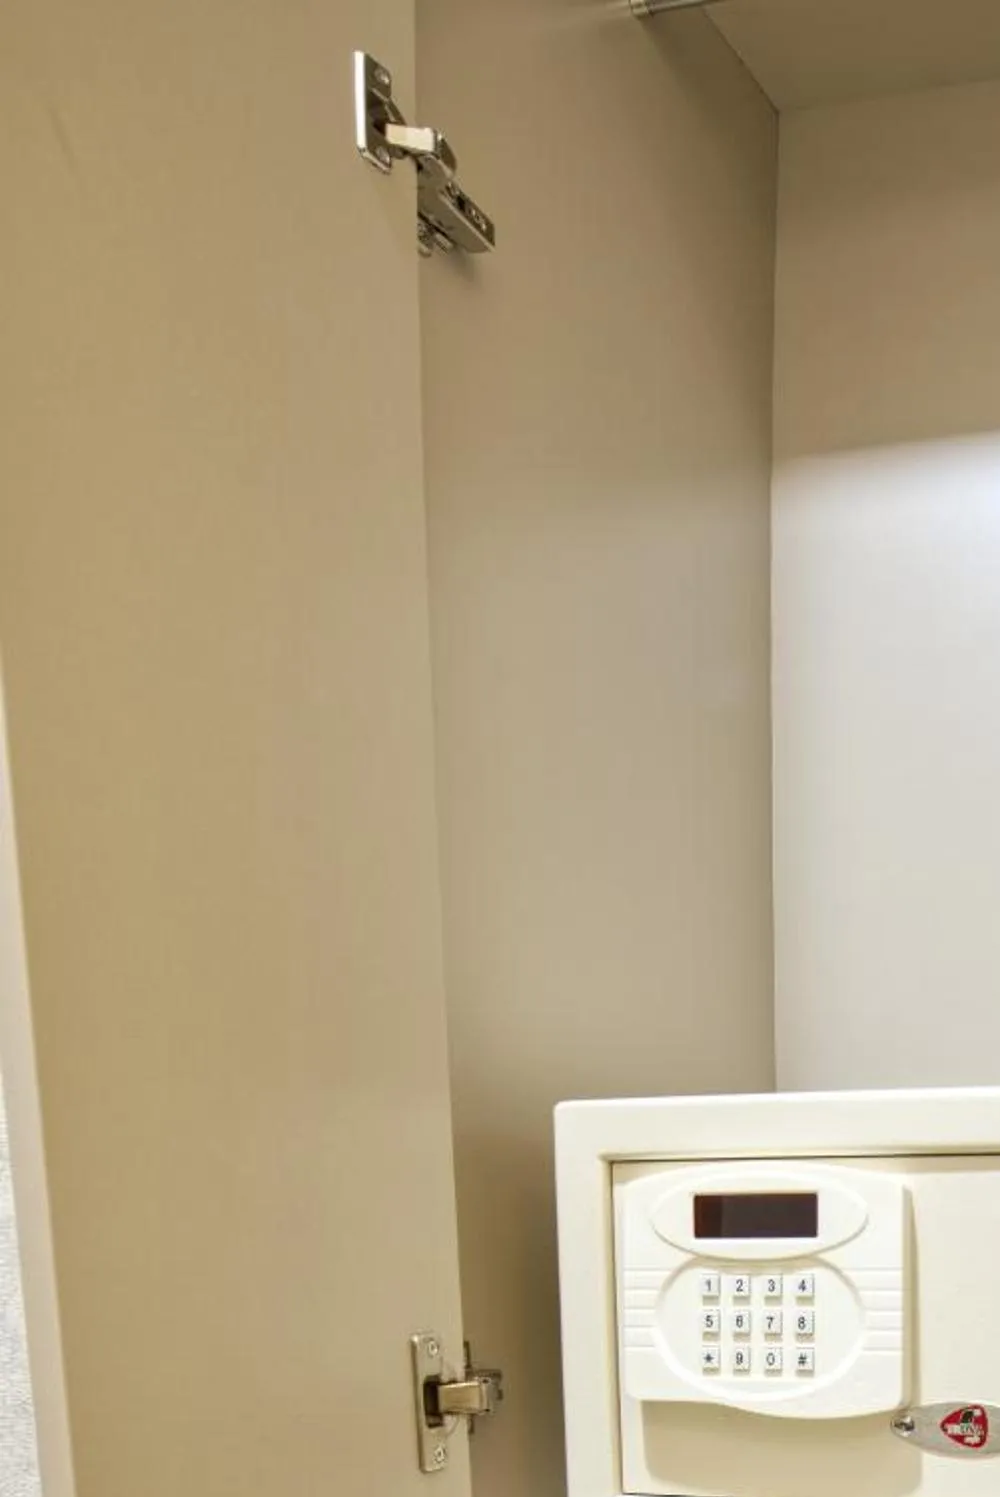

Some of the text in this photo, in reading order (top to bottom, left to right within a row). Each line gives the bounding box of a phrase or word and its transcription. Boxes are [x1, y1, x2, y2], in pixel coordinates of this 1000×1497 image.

[736, 1279, 744, 1292] 2
[768, 1279, 776, 1292] 3
[798, 1279, 807, 1292] 4
[705, 1315, 806, 1330] 5 6 7 8
[736, 1352, 744, 1365] 9
[766, 1352, 776, 1366] 0
